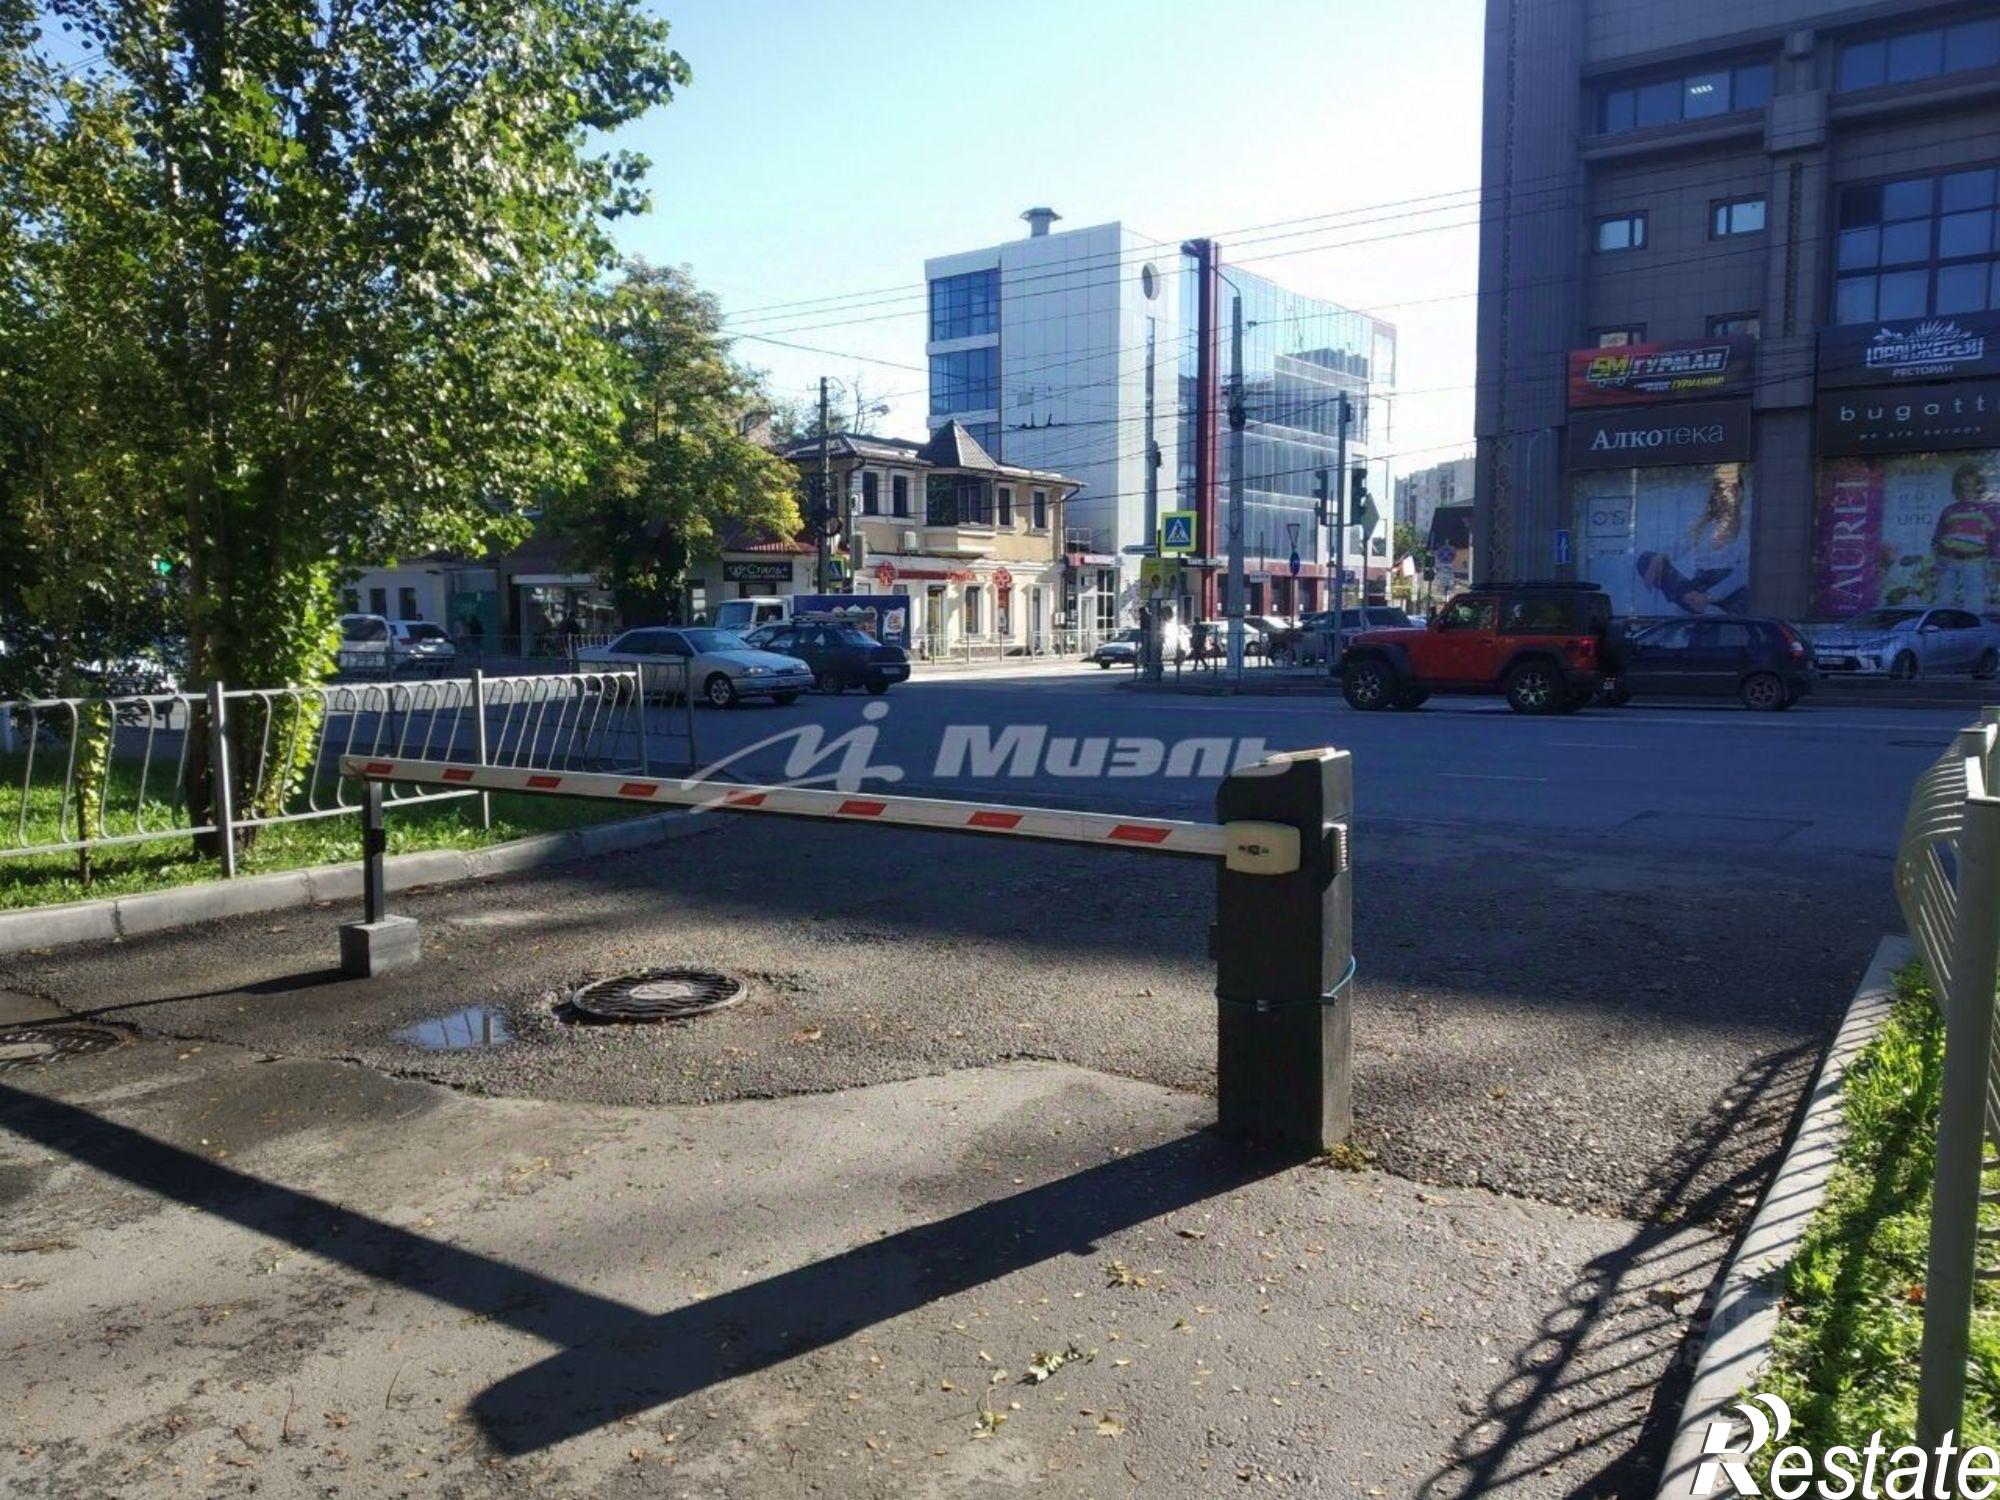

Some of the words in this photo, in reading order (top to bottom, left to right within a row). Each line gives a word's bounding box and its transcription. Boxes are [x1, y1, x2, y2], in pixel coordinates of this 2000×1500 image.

[1631, 352, 1723, 375] ГУРМАН
[1892, 364, 1954, 377] РЕСТОРАН
[1840, 395, 2000, 422] bugatt
[1590, 424, 1724, 451] Алкотека
